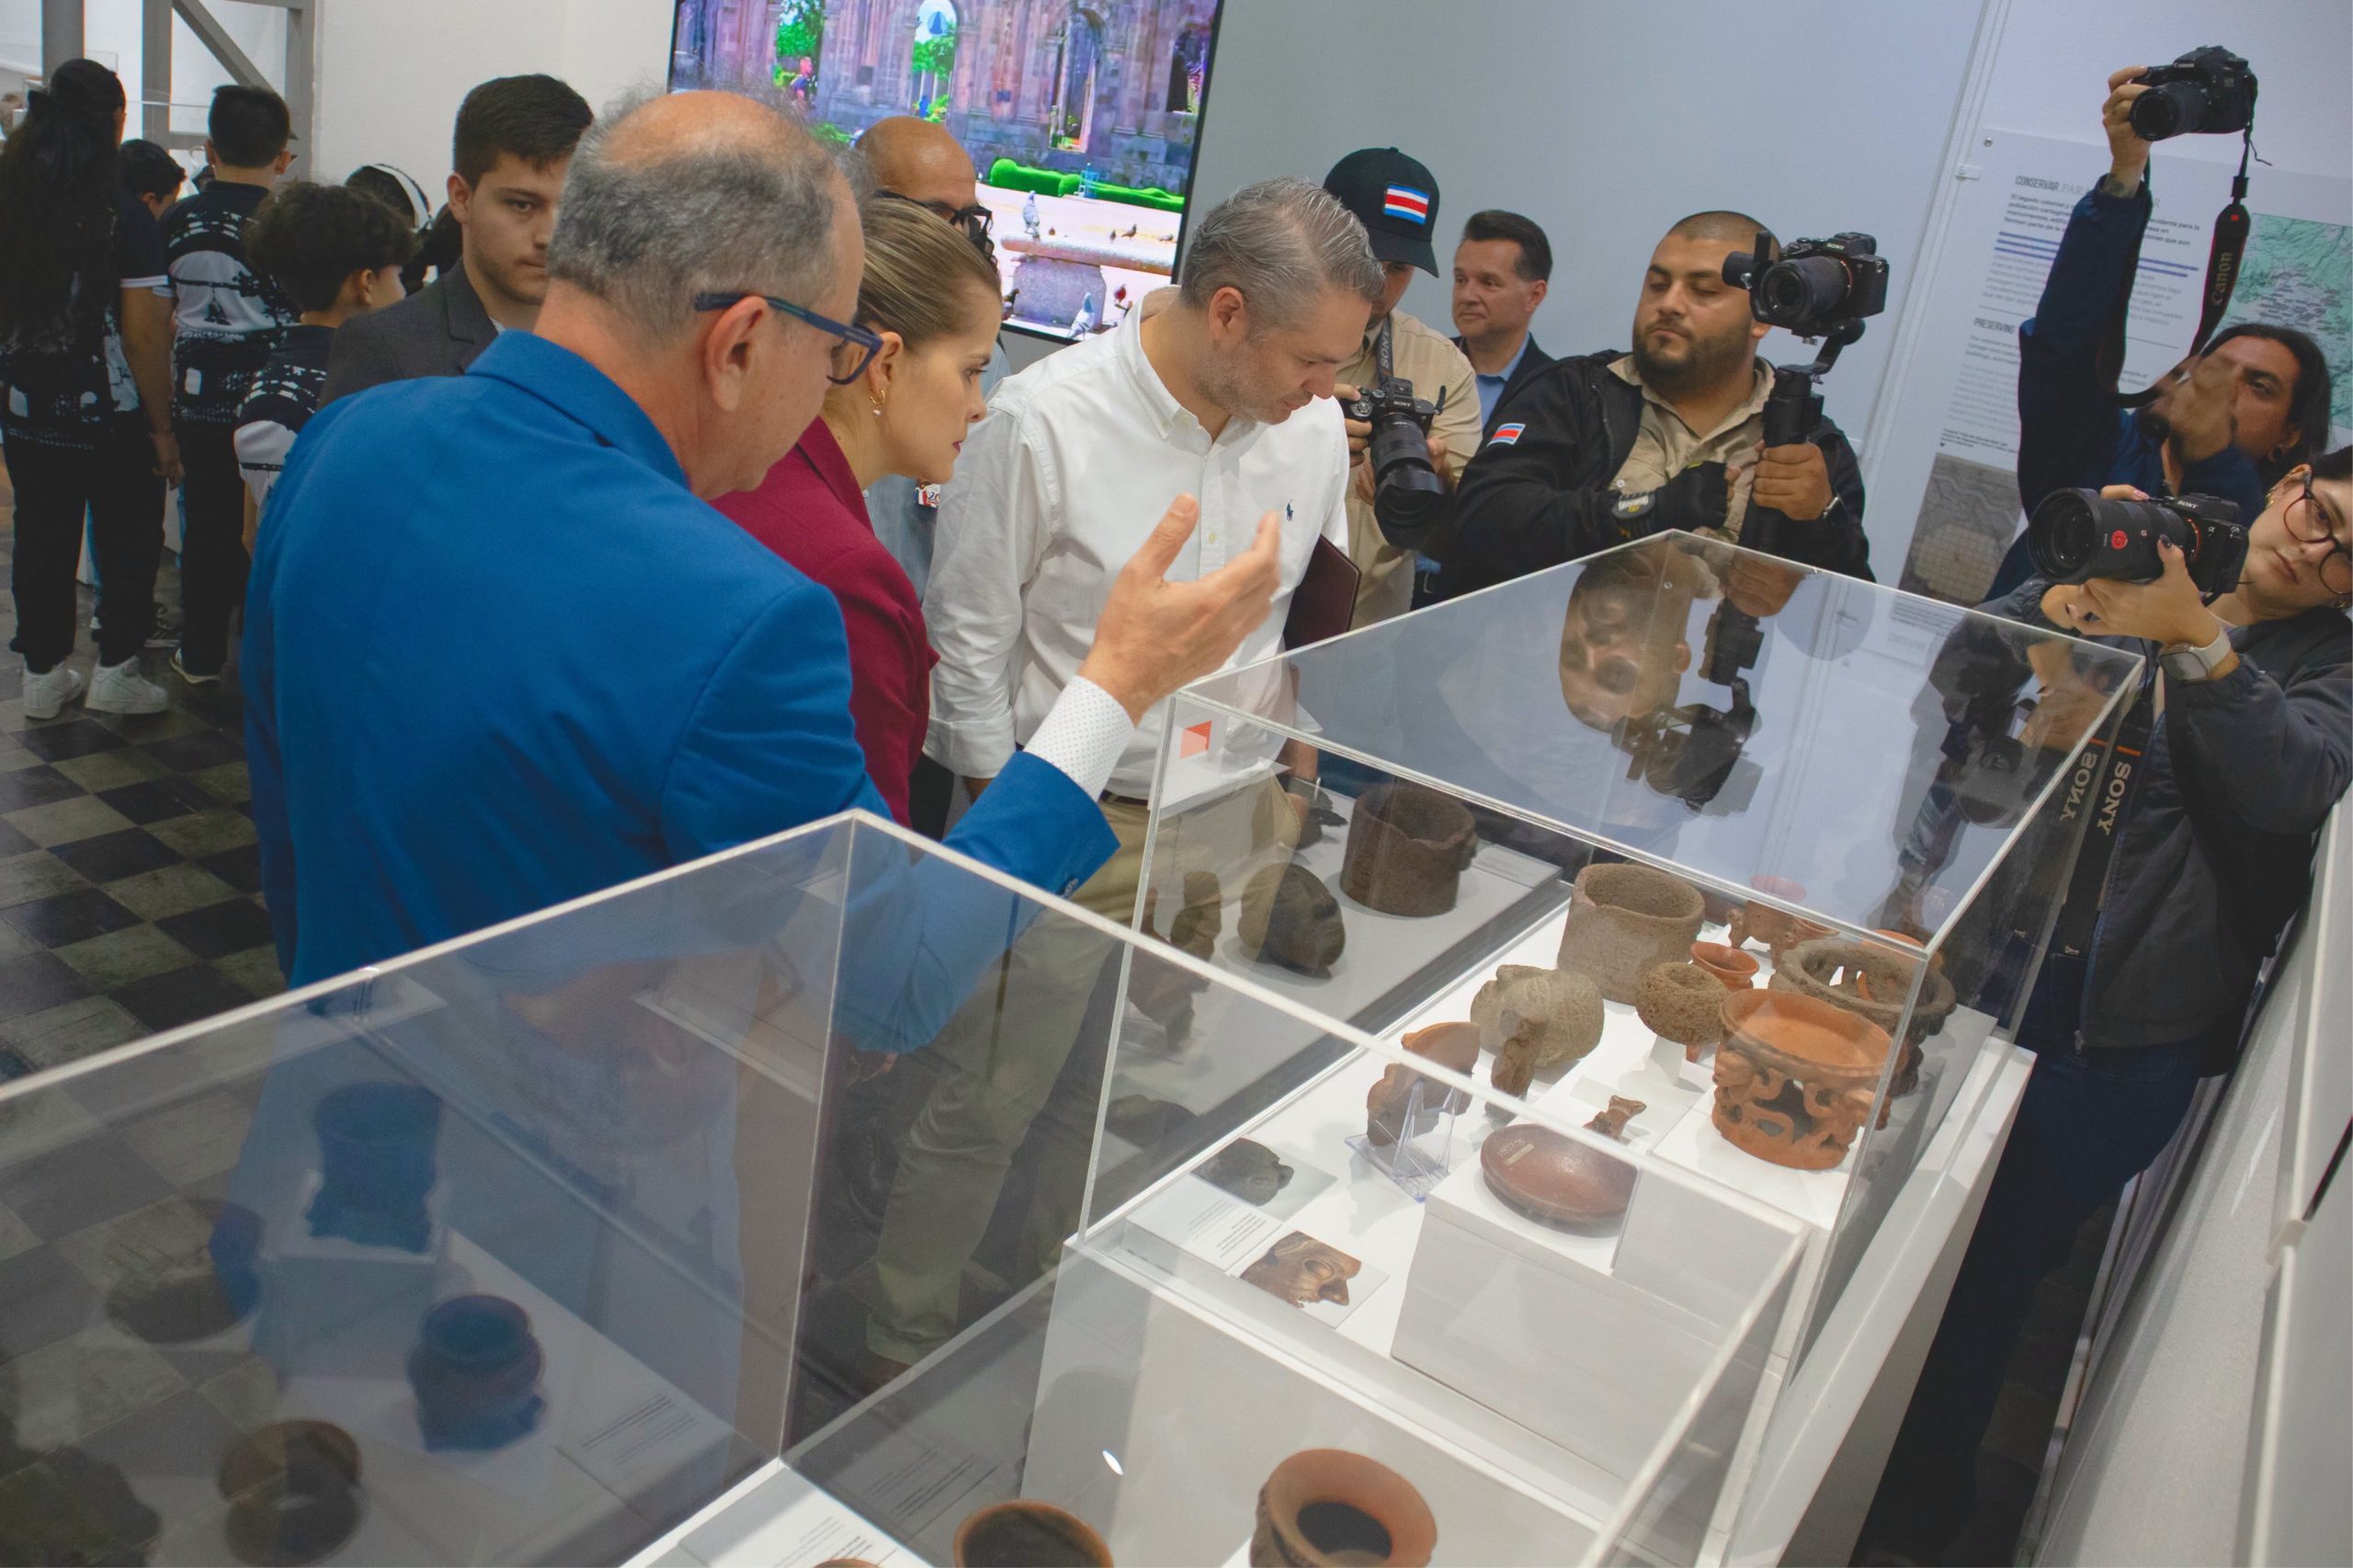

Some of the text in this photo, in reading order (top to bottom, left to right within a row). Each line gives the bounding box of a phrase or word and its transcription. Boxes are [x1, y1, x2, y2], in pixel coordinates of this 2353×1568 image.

[2015, 175, 2060, 190] CONSERVAR
[2211, 252, 2233, 306] Canon
[1973, 317, 2016, 335] PRESERVING
[1381, 329, 1390, 368] SONY
[2177, 500, 2199, 509] SONY
[2097, 761, 2131, 835] SONY
